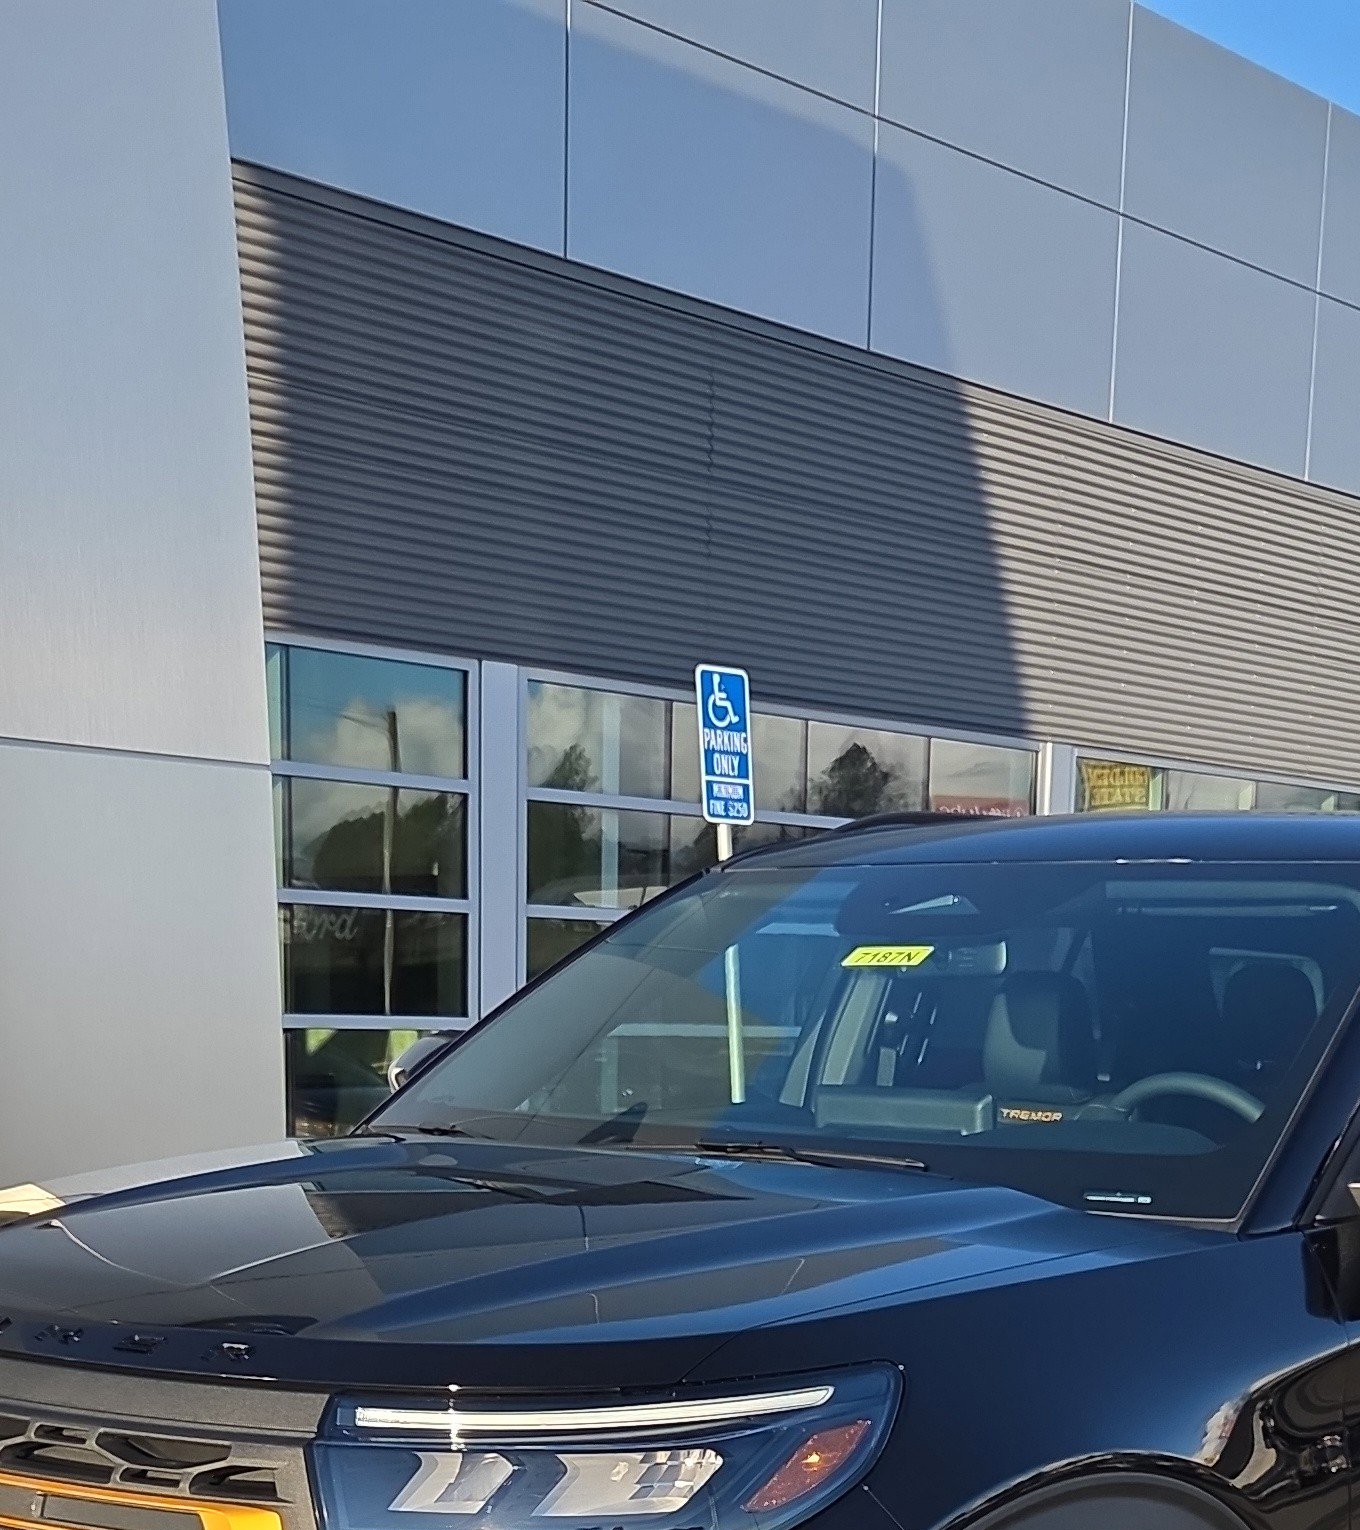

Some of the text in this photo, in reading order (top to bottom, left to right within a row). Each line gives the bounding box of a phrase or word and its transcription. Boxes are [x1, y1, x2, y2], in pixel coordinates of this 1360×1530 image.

[703, 728, 748, 754] PARKING
[713, 752, 740, 776] ONLY
[1000, 1108, 1063, 1122] TREMOR
